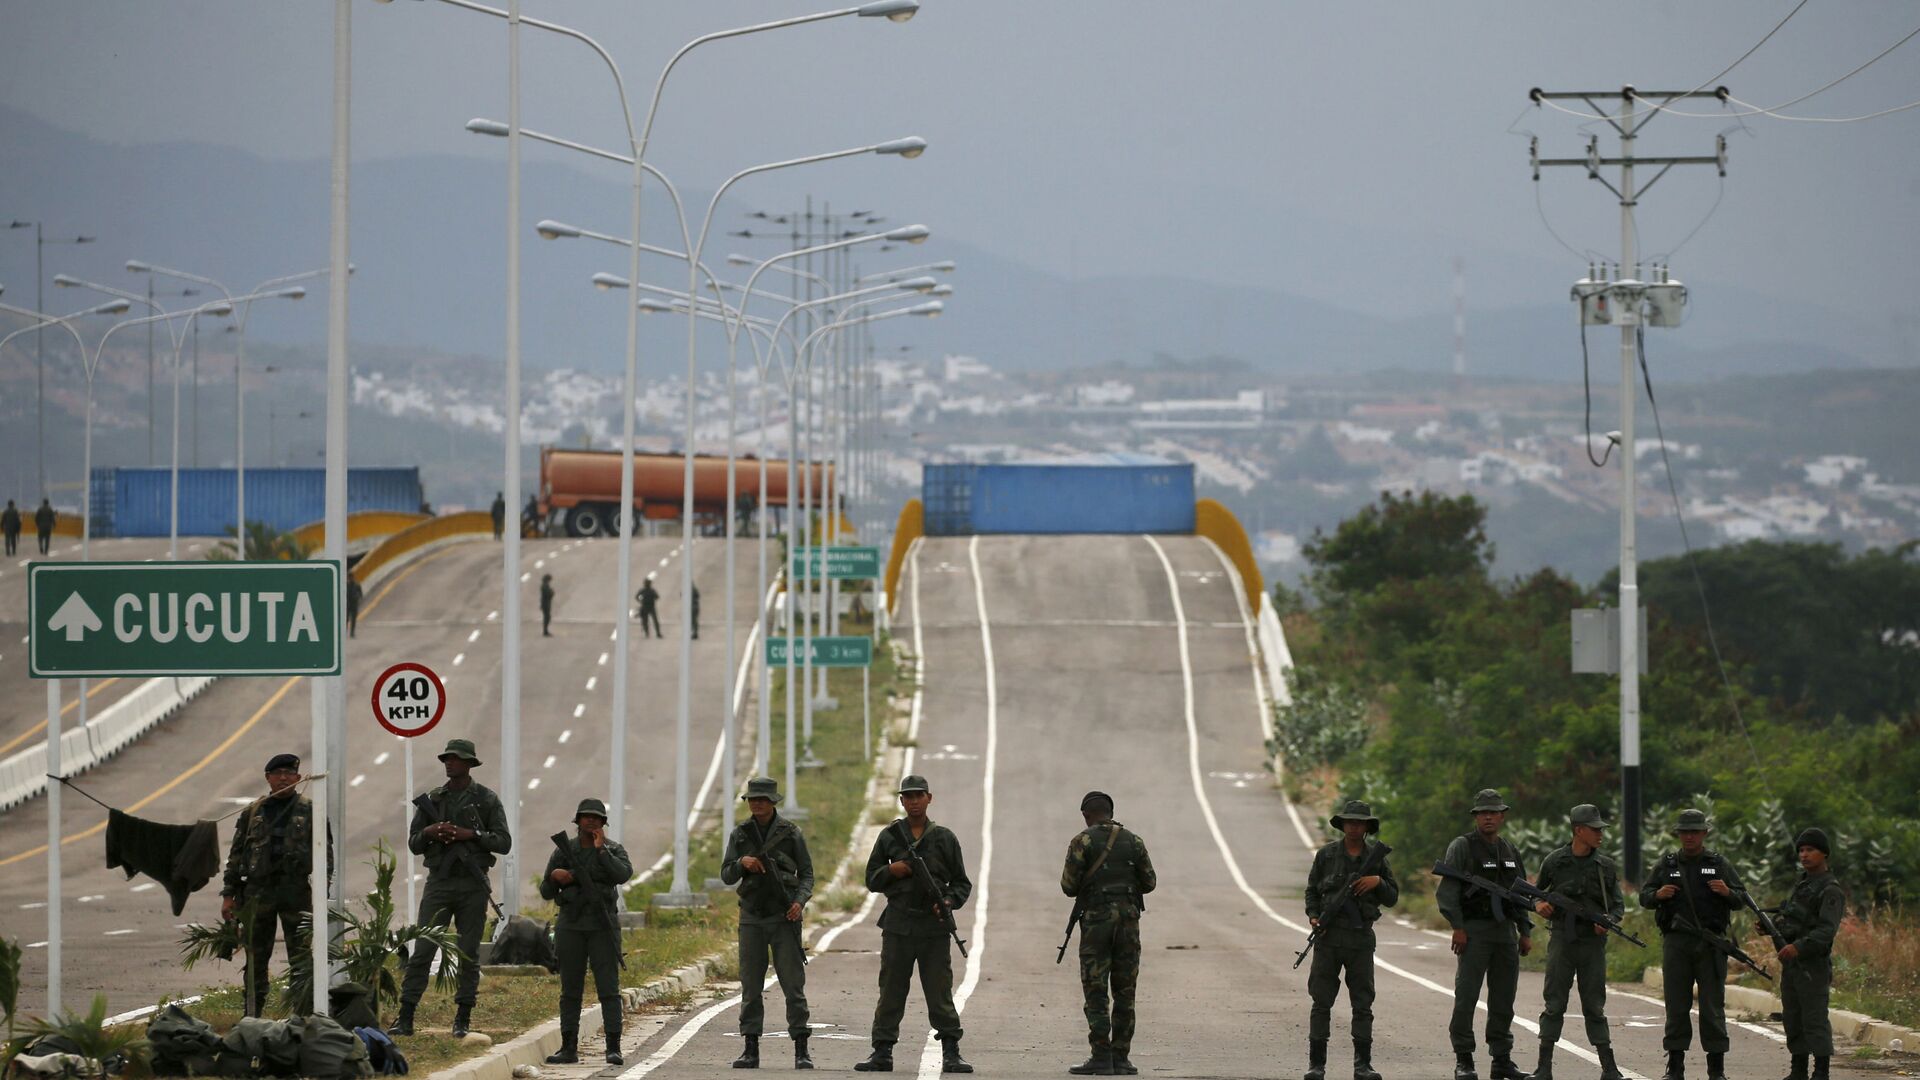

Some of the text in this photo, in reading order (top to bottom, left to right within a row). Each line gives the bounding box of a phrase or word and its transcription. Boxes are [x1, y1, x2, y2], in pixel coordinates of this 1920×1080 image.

[113, 592, 320, 643] CUCUTA
[771, 646, 862, 658] CUUA 3 km
[387, 677, 430, 701] 40
[388, 705, 430, 720] KPH
